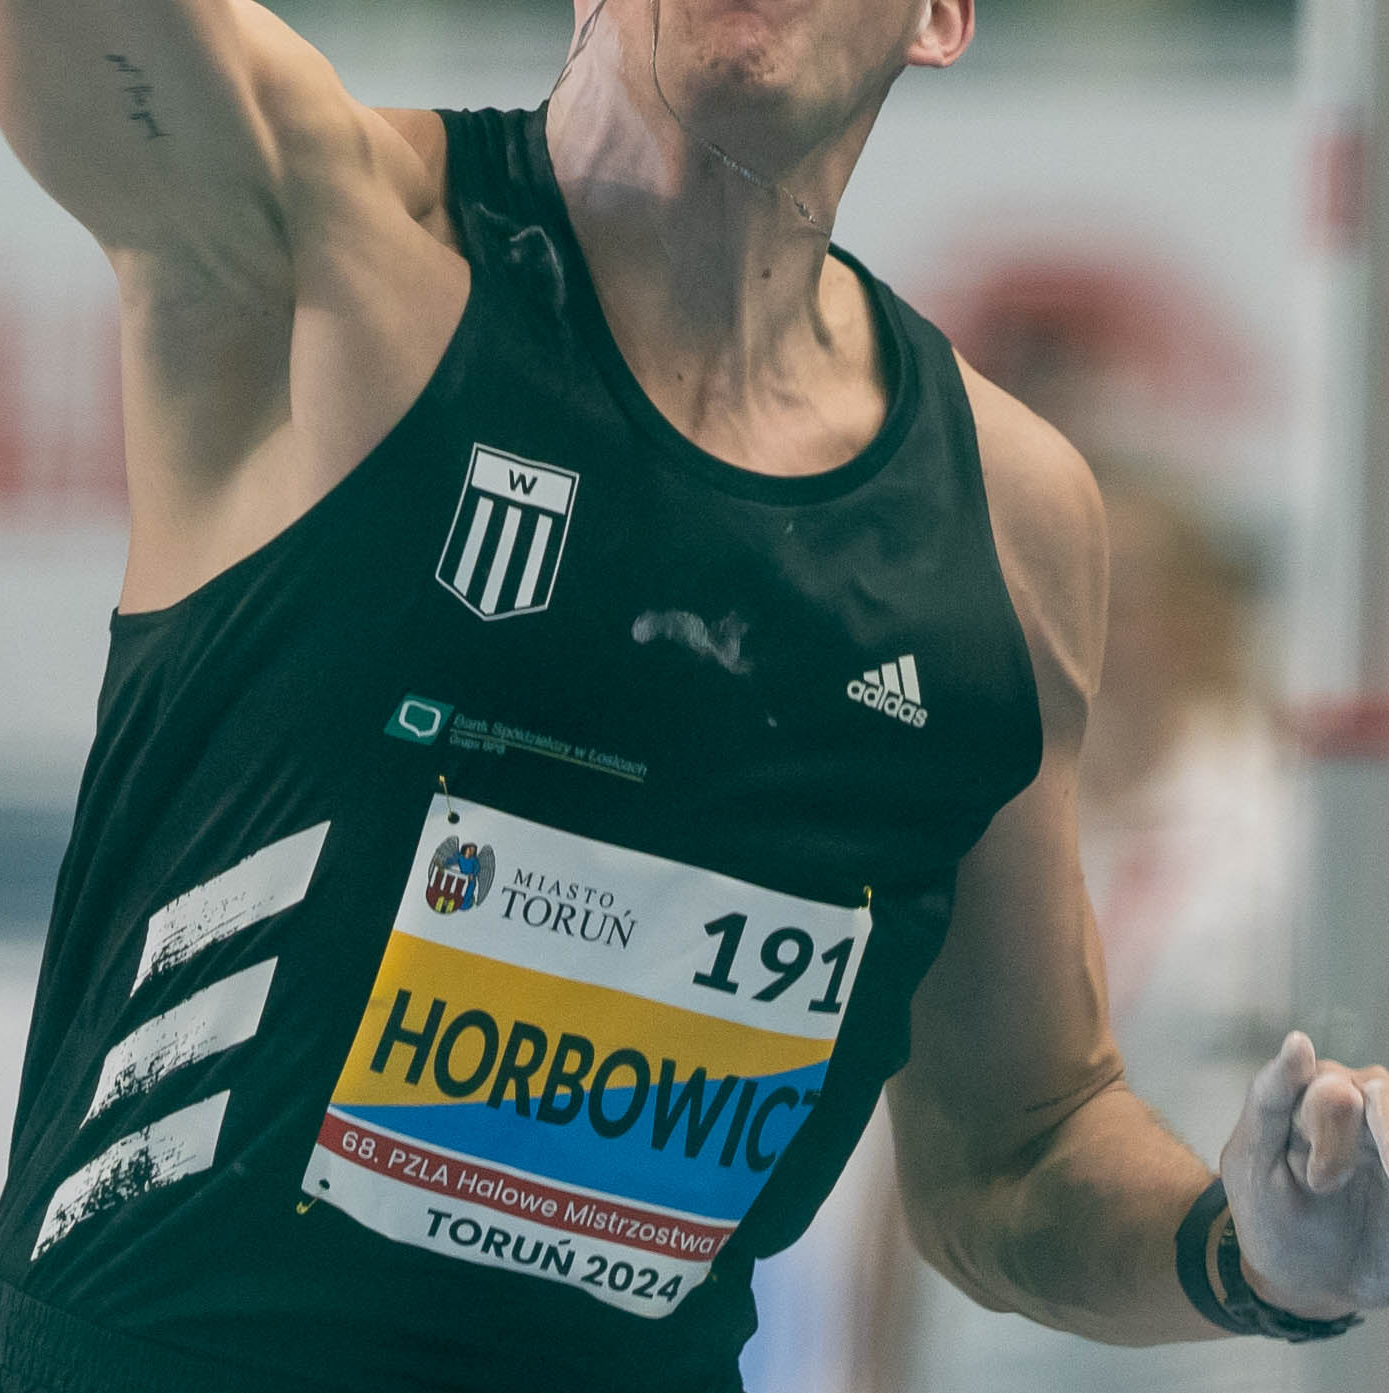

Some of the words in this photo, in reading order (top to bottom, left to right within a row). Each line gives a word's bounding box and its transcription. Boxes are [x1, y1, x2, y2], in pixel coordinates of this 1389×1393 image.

[509, 468, 538, 496] W
[846, 679, 929, 728] adidas
[500, 885, 638, 950] TORUŃ
[513, 867, 615, 909] MIASTO
[691, 911, 856, 1016] 191
[369, 988, 822, 1174] HORBOWIC
[341, 1130, 379, 1164] 68.
[387, 1147, 449, 1188] PZLA
[457, 1169, 559, 1219] Halowe
[563, 1200, 715, 1255] Mistrzostwa
[427, 1208, 576, 1278] TORUŃ
[580, 1254, 684, 1303] 2024
